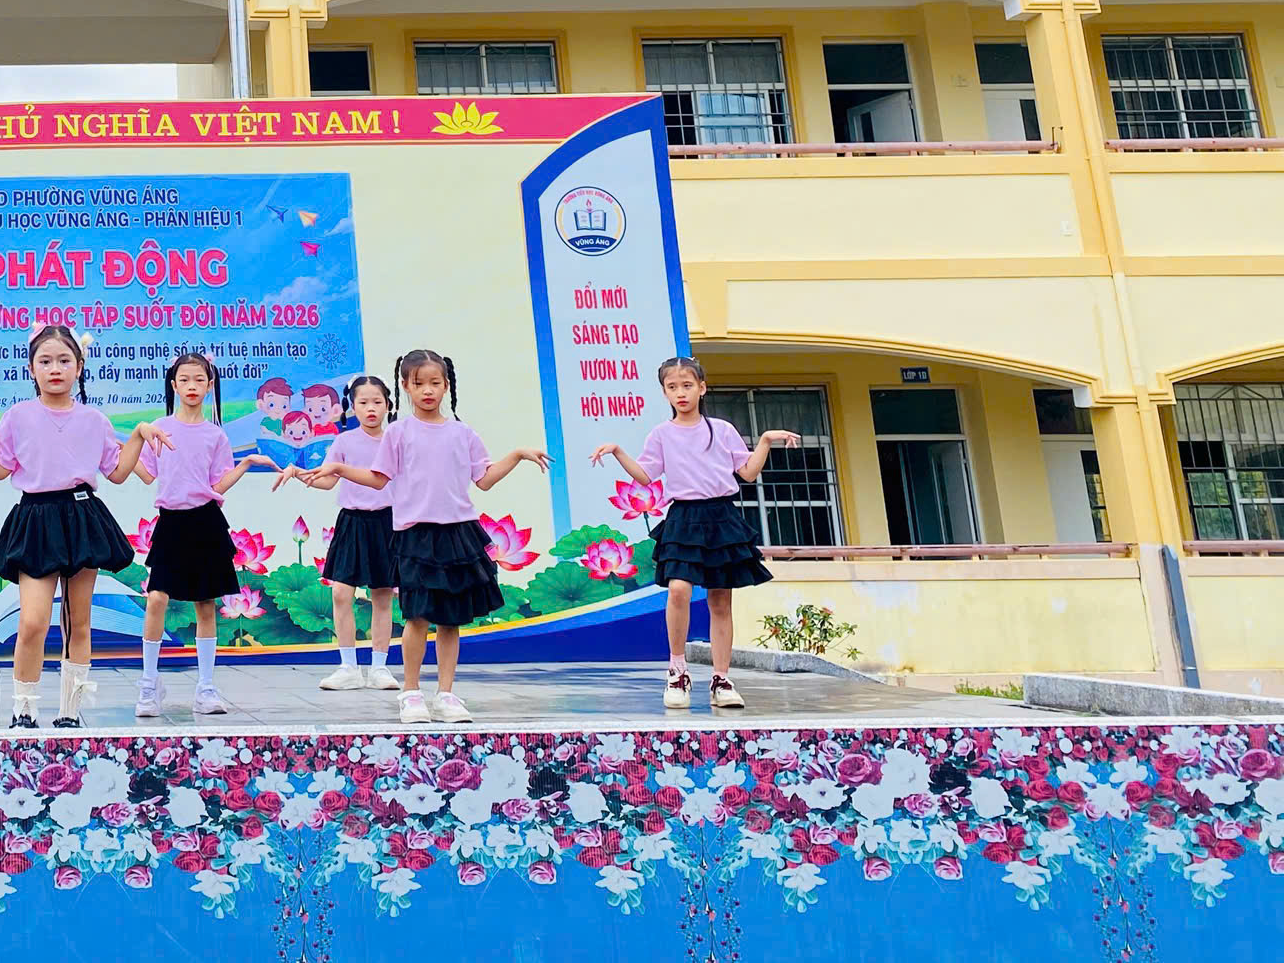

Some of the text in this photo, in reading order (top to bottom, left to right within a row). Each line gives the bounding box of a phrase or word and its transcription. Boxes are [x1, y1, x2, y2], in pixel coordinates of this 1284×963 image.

[54, 108, 179, 137] NGHĨA
[190, 105, 280, 143] VIỆT
[291, 111, 382, 136] NAM
[392, 109, 401, 134] !
[12, 187, 85, 207] PHƯỜNG
[90, 186, 137, 206] VŨNG
[142, 184, 178, 205] ÁNG
[8, 211, 41, 232] HỌC
[45, 208, 91, 228] VŨNG
[95, 208, 129, 228] ÁNG
[144, 206, 188, 227] PHÂN
[193, 205, 231, 230] HIỆU
[235, 209, 243, 226] 1
[102, 240, 228, 296] ĐỘNG
[574, 281, 628, 309] ĐỔI MỚI
[81, 301, 119, 334] TẬP
[124, 297, 176, 328] SUỐT
[180, 299, 217, 327] ĐỜI
[221, 300, 266, 326] NĂM
[271, 304, 320, 327] 2026
[572, 320, 639, 349] SÁNG TẠO
[105, 342, 135, 361] công
[139, 342, 170, 361] nghệ
[174, 340, 189, 357] số
[191, 341, 206, 356] và
[228, 341, 248, 360] tuệ
[252, 341, 282, 357] nhân
[286, 343, 307, 361] tạo
[3, 366, 18, 381] xã
[99, 361, 120, 383] đẩy
[124, 364, 157, 382] mạnh
[243, 363, 268, 379] đời”
[580, 358, 639, 381] VƯƠN XA
[107, 393, 118, 404] 10
[120, 393, 141, 404] năm
[581, 391, 644, 421] HỘI NHẬP
